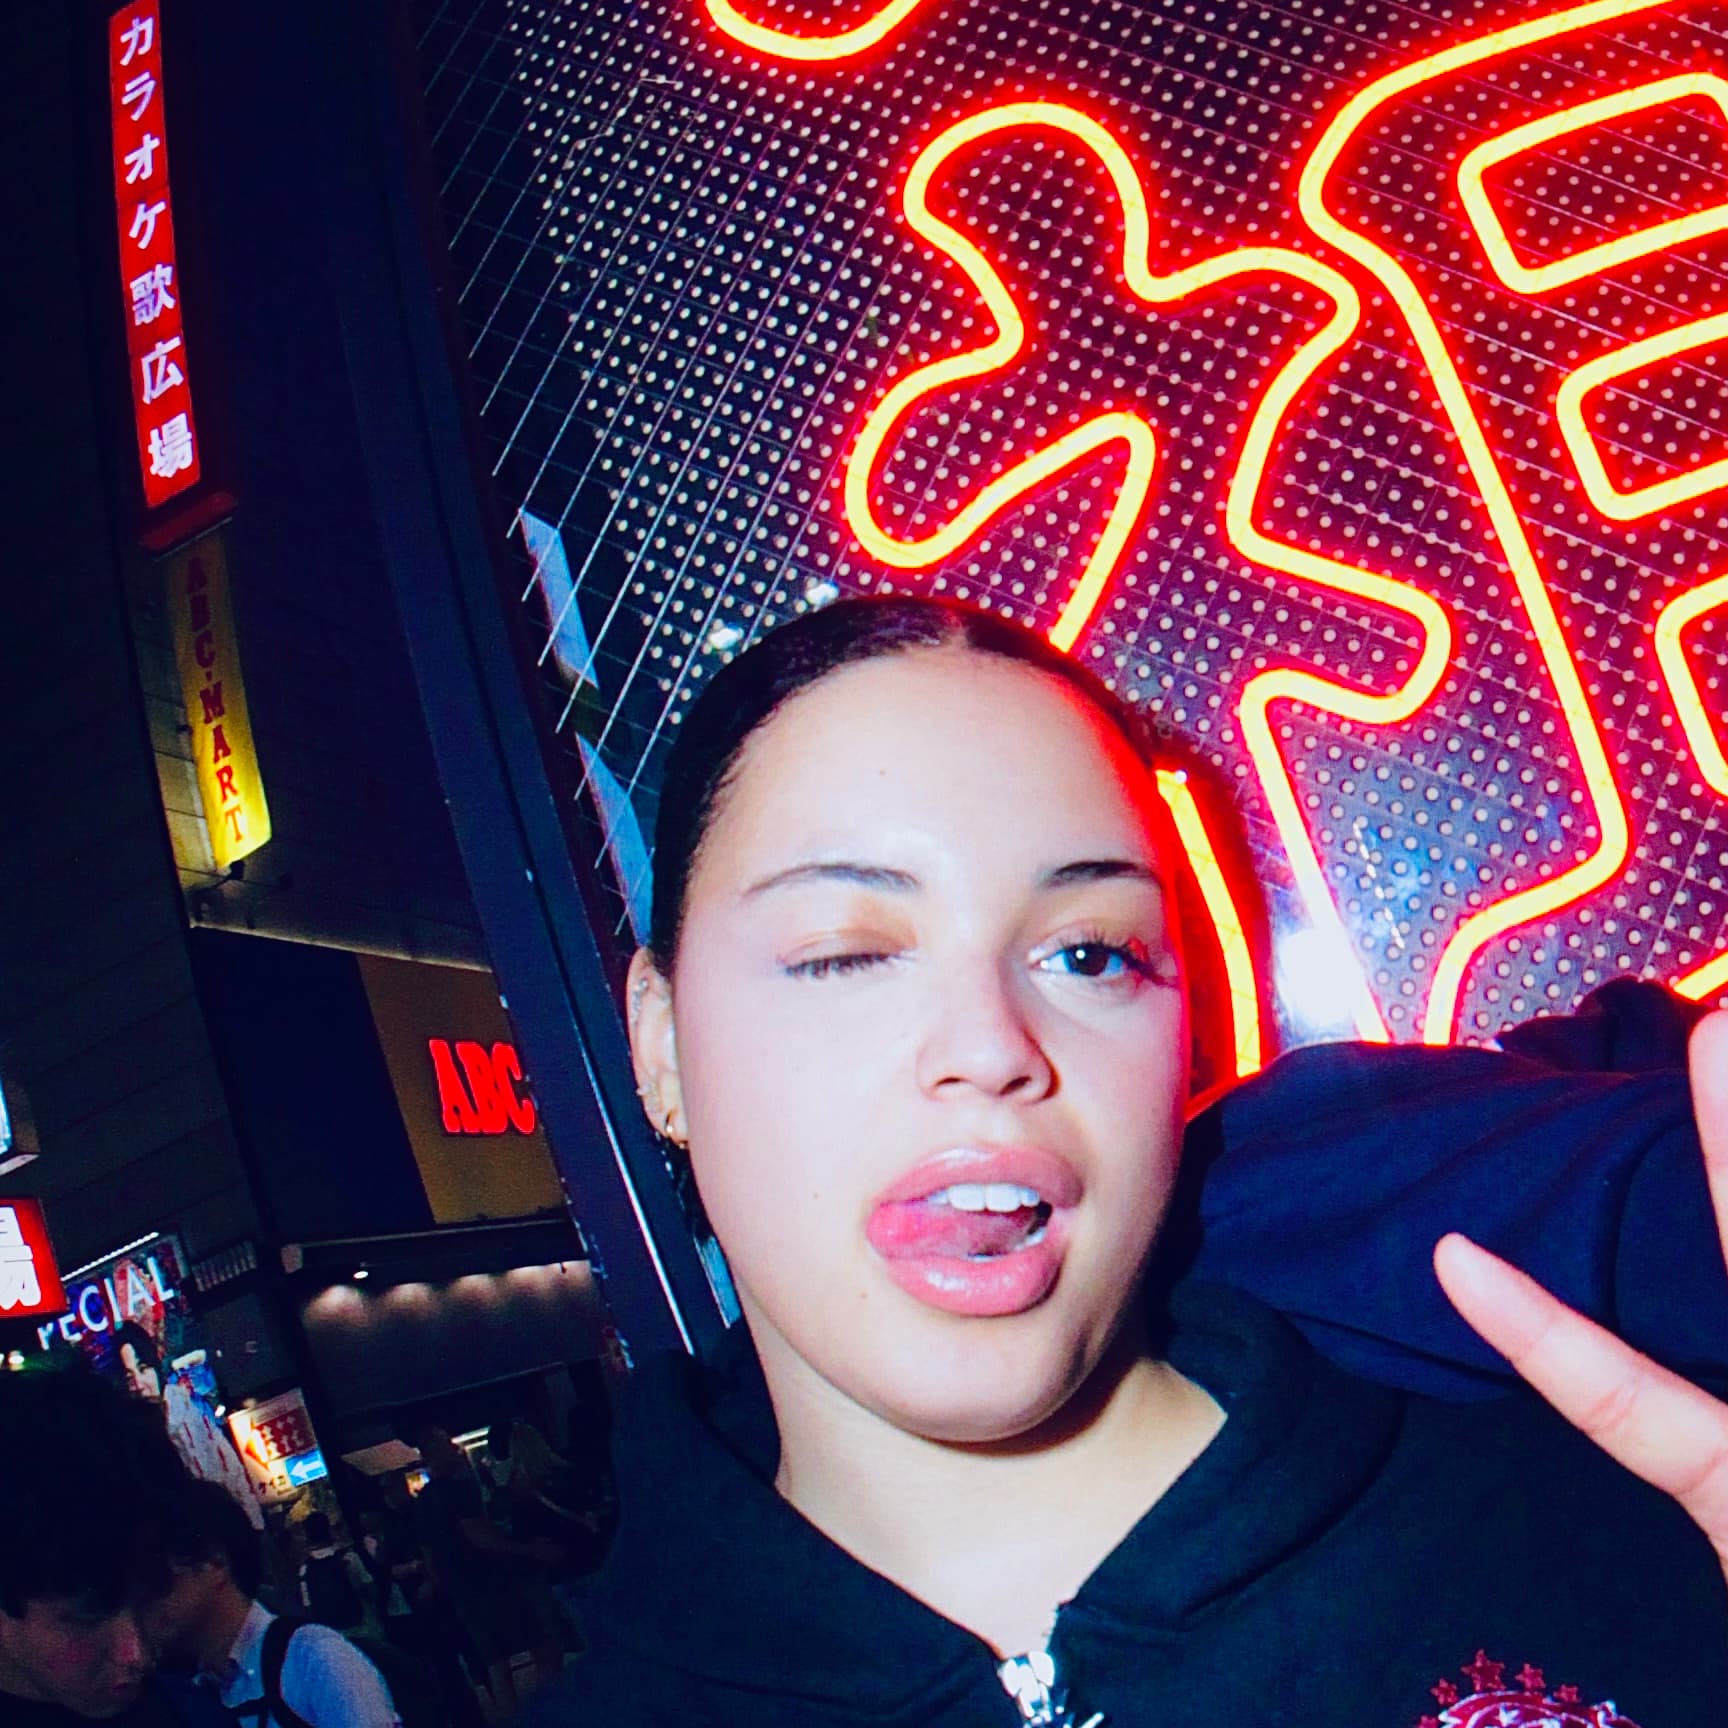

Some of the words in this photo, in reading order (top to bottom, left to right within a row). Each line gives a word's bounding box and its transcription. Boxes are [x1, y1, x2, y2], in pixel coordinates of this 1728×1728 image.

[119, 16, 194, 479] カラオケ歌広場
[428, 1038, 536, 1135] ABC
